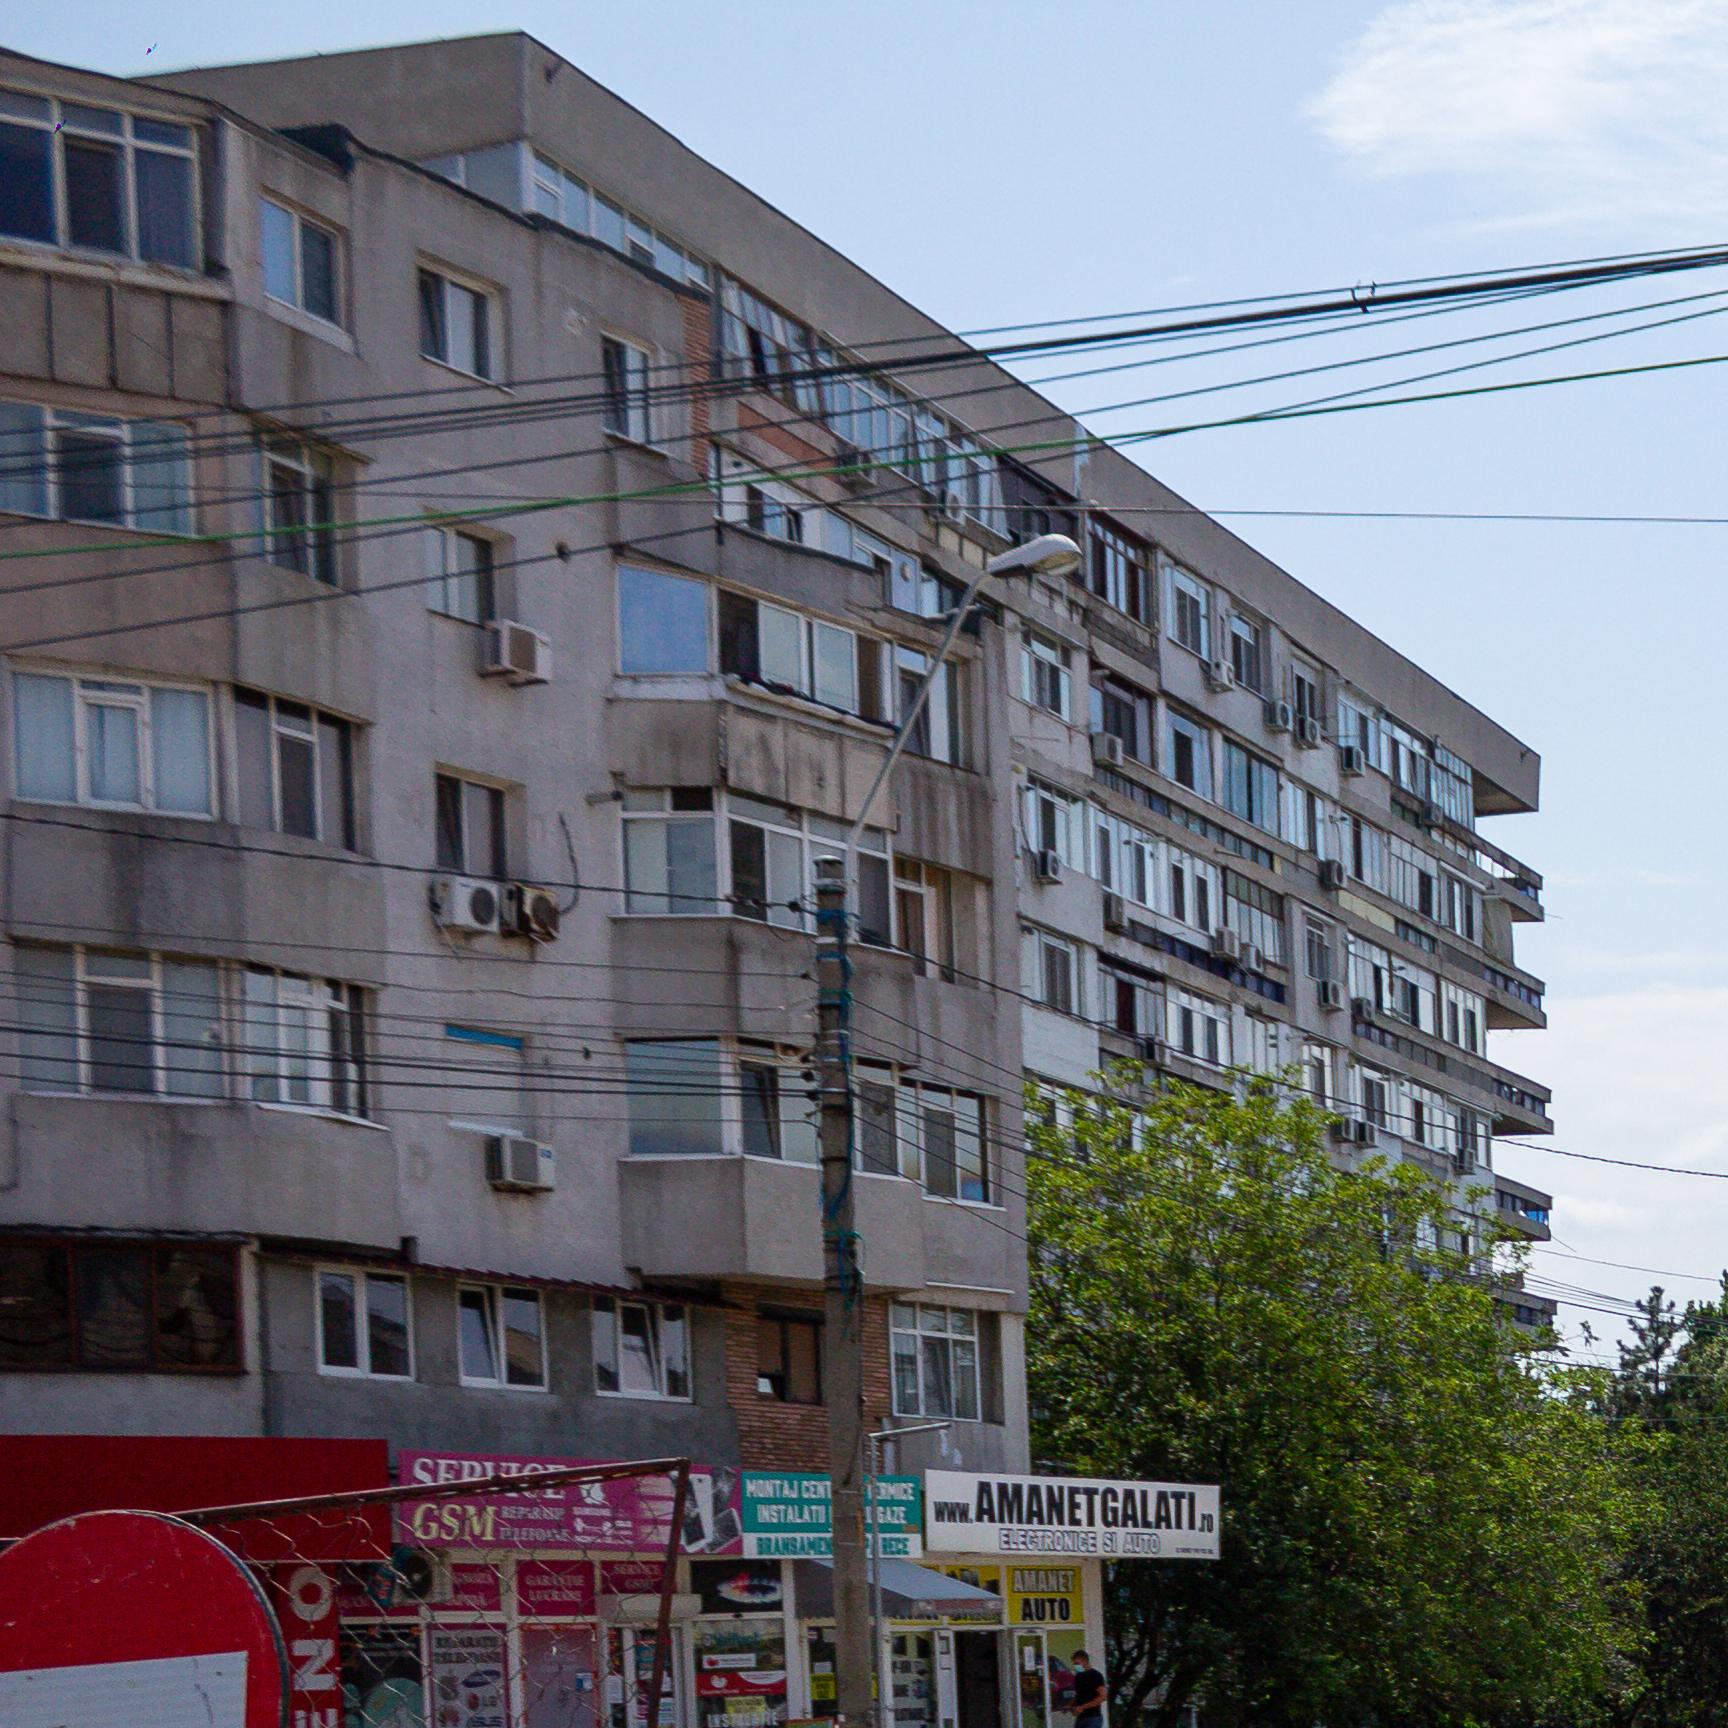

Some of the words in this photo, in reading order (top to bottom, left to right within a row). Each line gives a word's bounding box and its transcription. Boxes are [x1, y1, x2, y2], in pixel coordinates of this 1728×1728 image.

[745, 1478, 799, 1499] MONTAJ
[411, 1503, 499, 1541] GSM
[1000, 1528, 1097, 1553] ELECTRONICE
[1102, 1532, 1119, 1553] SI
[1122, 1533, 1161, 1555] AUTO
[1013, 1568, 1075, 1593] AMANET
[1021, 1598, 1071, 1622] AUTO
